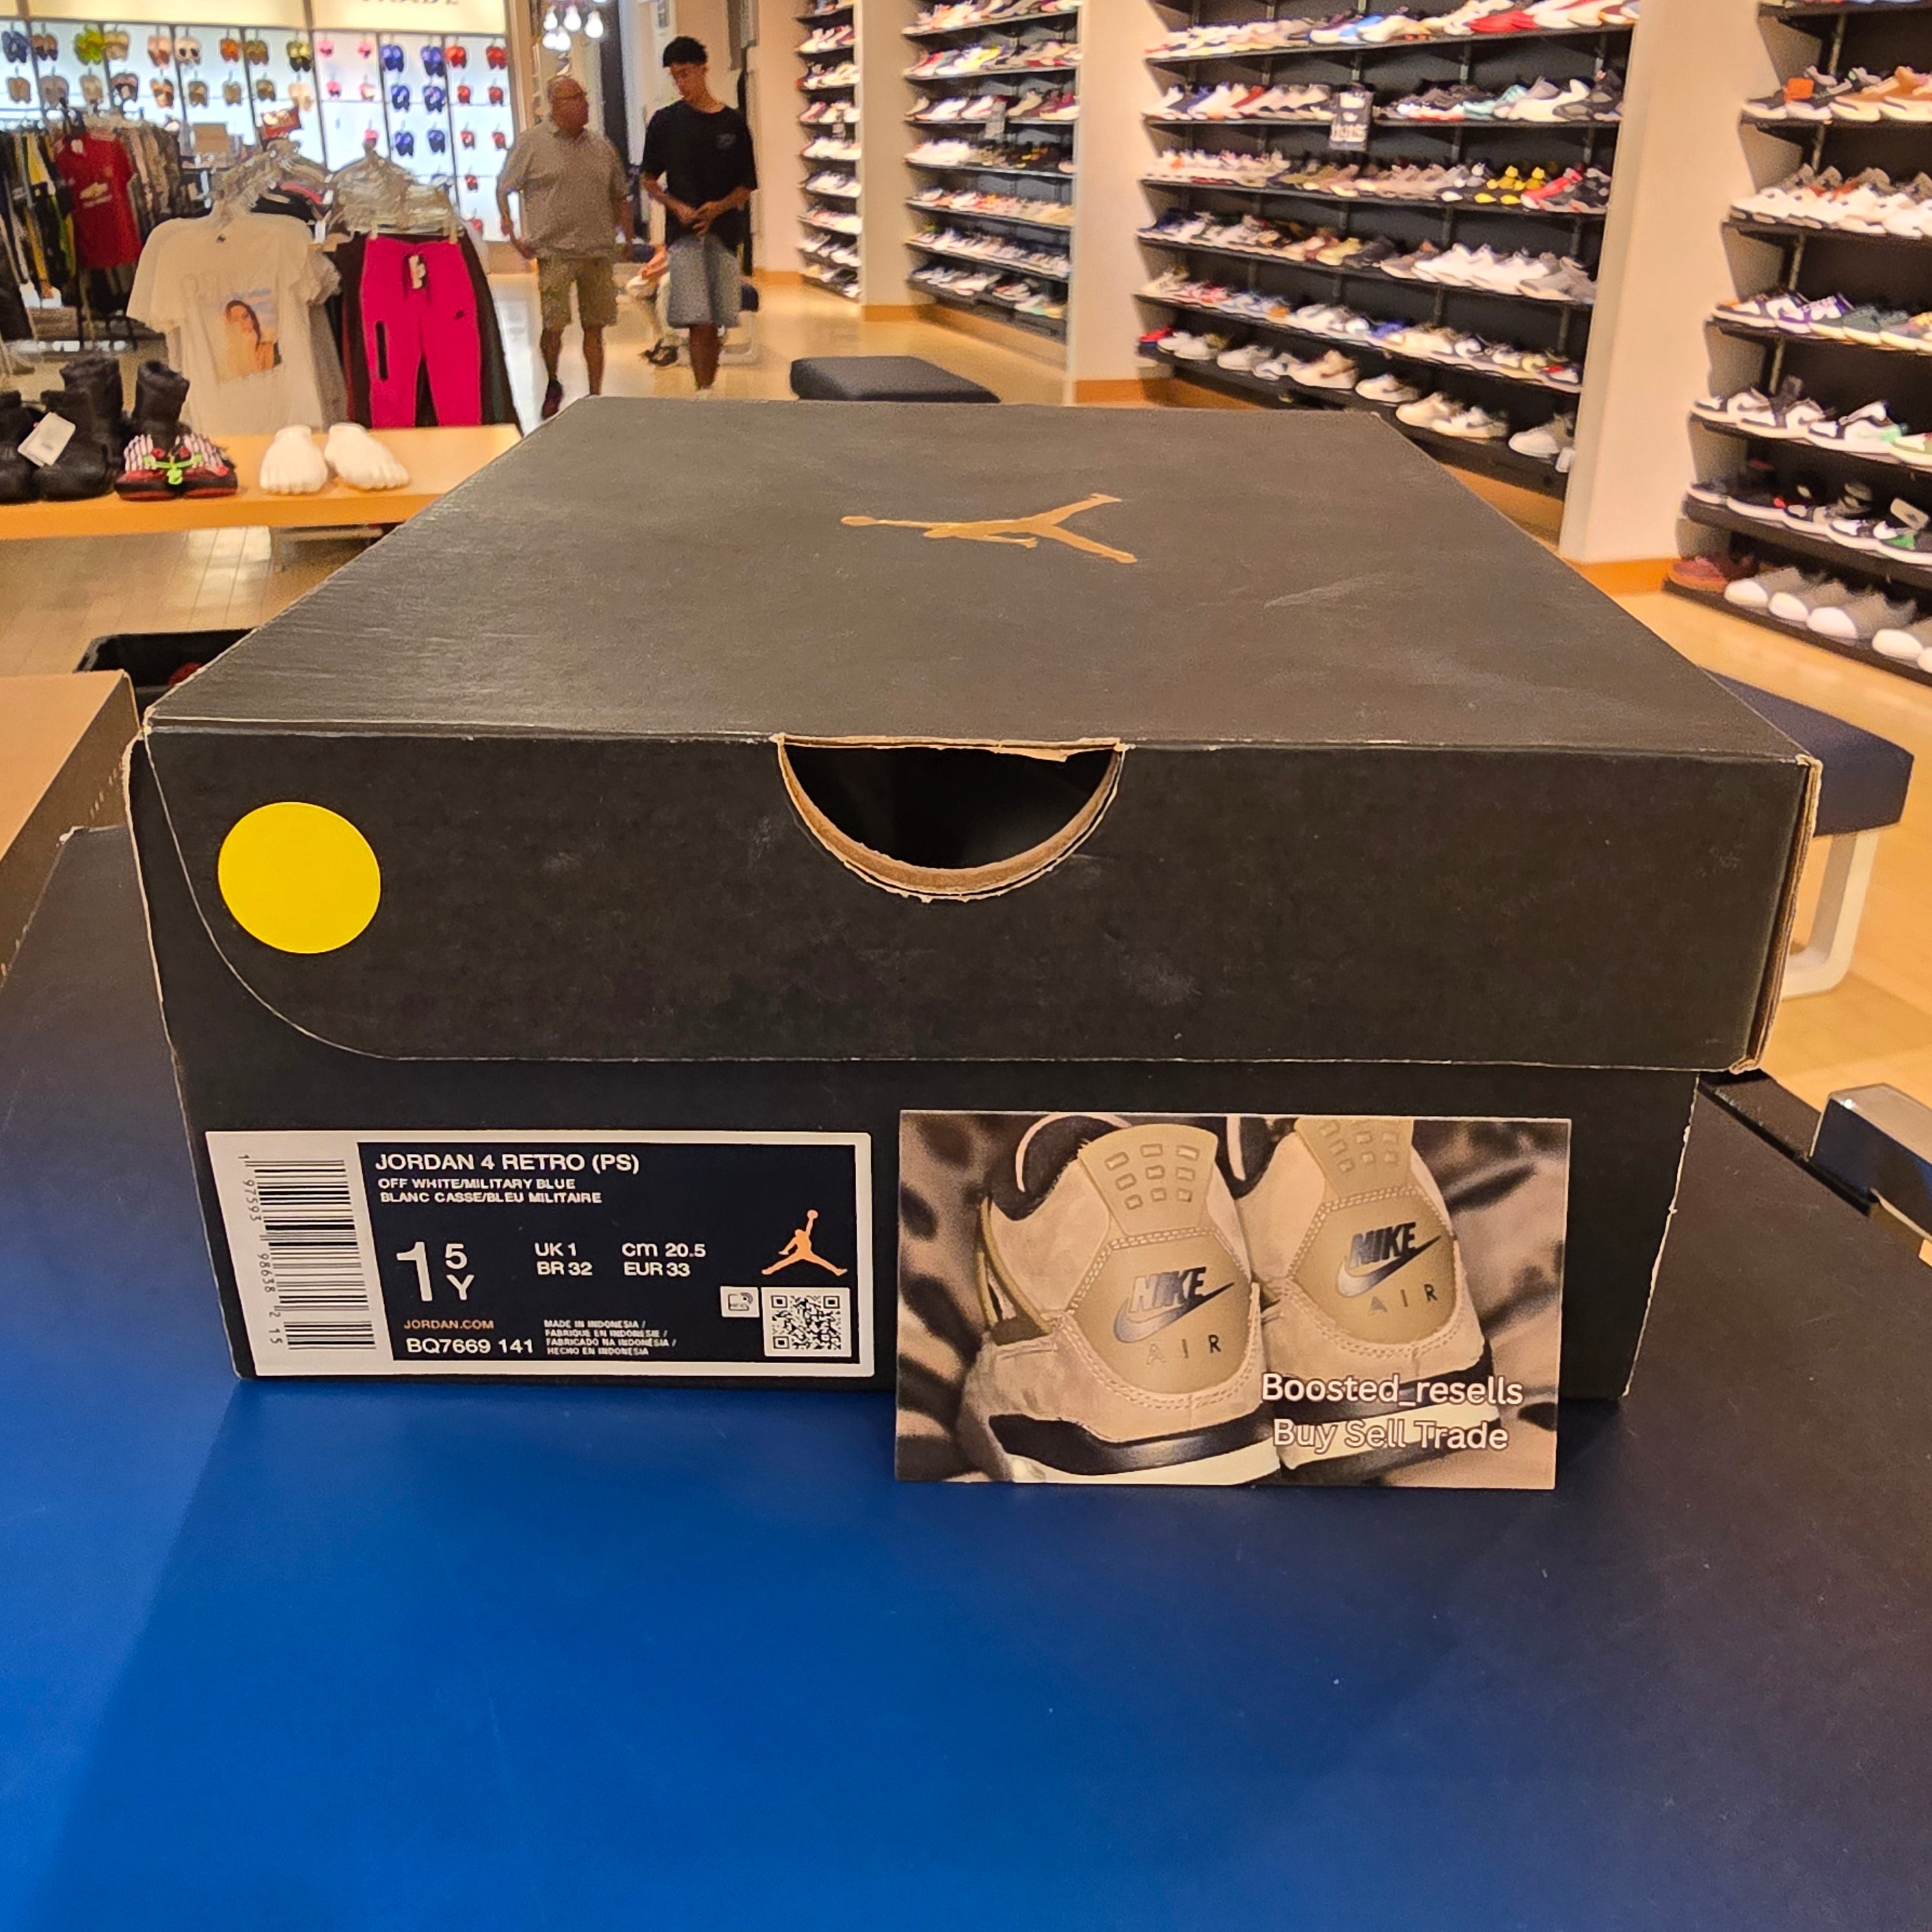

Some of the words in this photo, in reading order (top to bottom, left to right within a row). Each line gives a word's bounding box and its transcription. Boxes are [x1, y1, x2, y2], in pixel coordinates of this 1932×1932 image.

[375, 1153, 475, 1171] JORDAN
[480, 1154, 495, 1170] 4
[502, 1153, 585, 1171] RETRO
[591, 1153, 639, 1175] (PS)
[378, 1178, 408, 1189] OFF
[411, 1178, 533, 1189] WHITE/MILITARY
[535, 1178, 576, 1189] BLUE
[380, 1192, 430, 1203] BLANC
[434, 1192, 524, 1203] CASSE/BLEU
[528, 1192, 602, 1204] MILITAIRE
[242, 1179, 262, 1222] 97593
[257, 1253, 276, 1293] 98638
[1349, 1222, 1417, 1268] NIKE
[535, 1242, 564, 1257] UK
[568, 1242, 577, 1257] 1
[664, 1242, 706, 1257] 20.5
[396, 1241, 433, 1302] 1
[445, 1243, 468, 1269] 5
[537, 1261, 564, 1275] BR
[568, 1262, 593, 1276] 32
[624, 1261, 663, 1276] EUR
[666, 1262, 690, 1277] 33
[446, 1274, 475, 1300] Y
[1128, 1266, 1207, 1313] NIKE
[1368, 1283, 1438, 1316] AIR
[404, 1320, 494, 1330] JORDAN.COM
[544, 1319, 571, 1328] MADE
[587, 1321, 639, 1329] INDONESIA
[406, 1337, 491, 1353] BQ7669
[498, 1339, 533, 1353] 141
[1146, 1333, 1222, 1366] AIR
[1262, 1373, 1524, 1407] Boosted_resells
[1273, 1418, 1337, 1454] Buy
[1345, 1419, 1406, 1449] Sell
[1415, 1421, 1508, 1450] Trade
